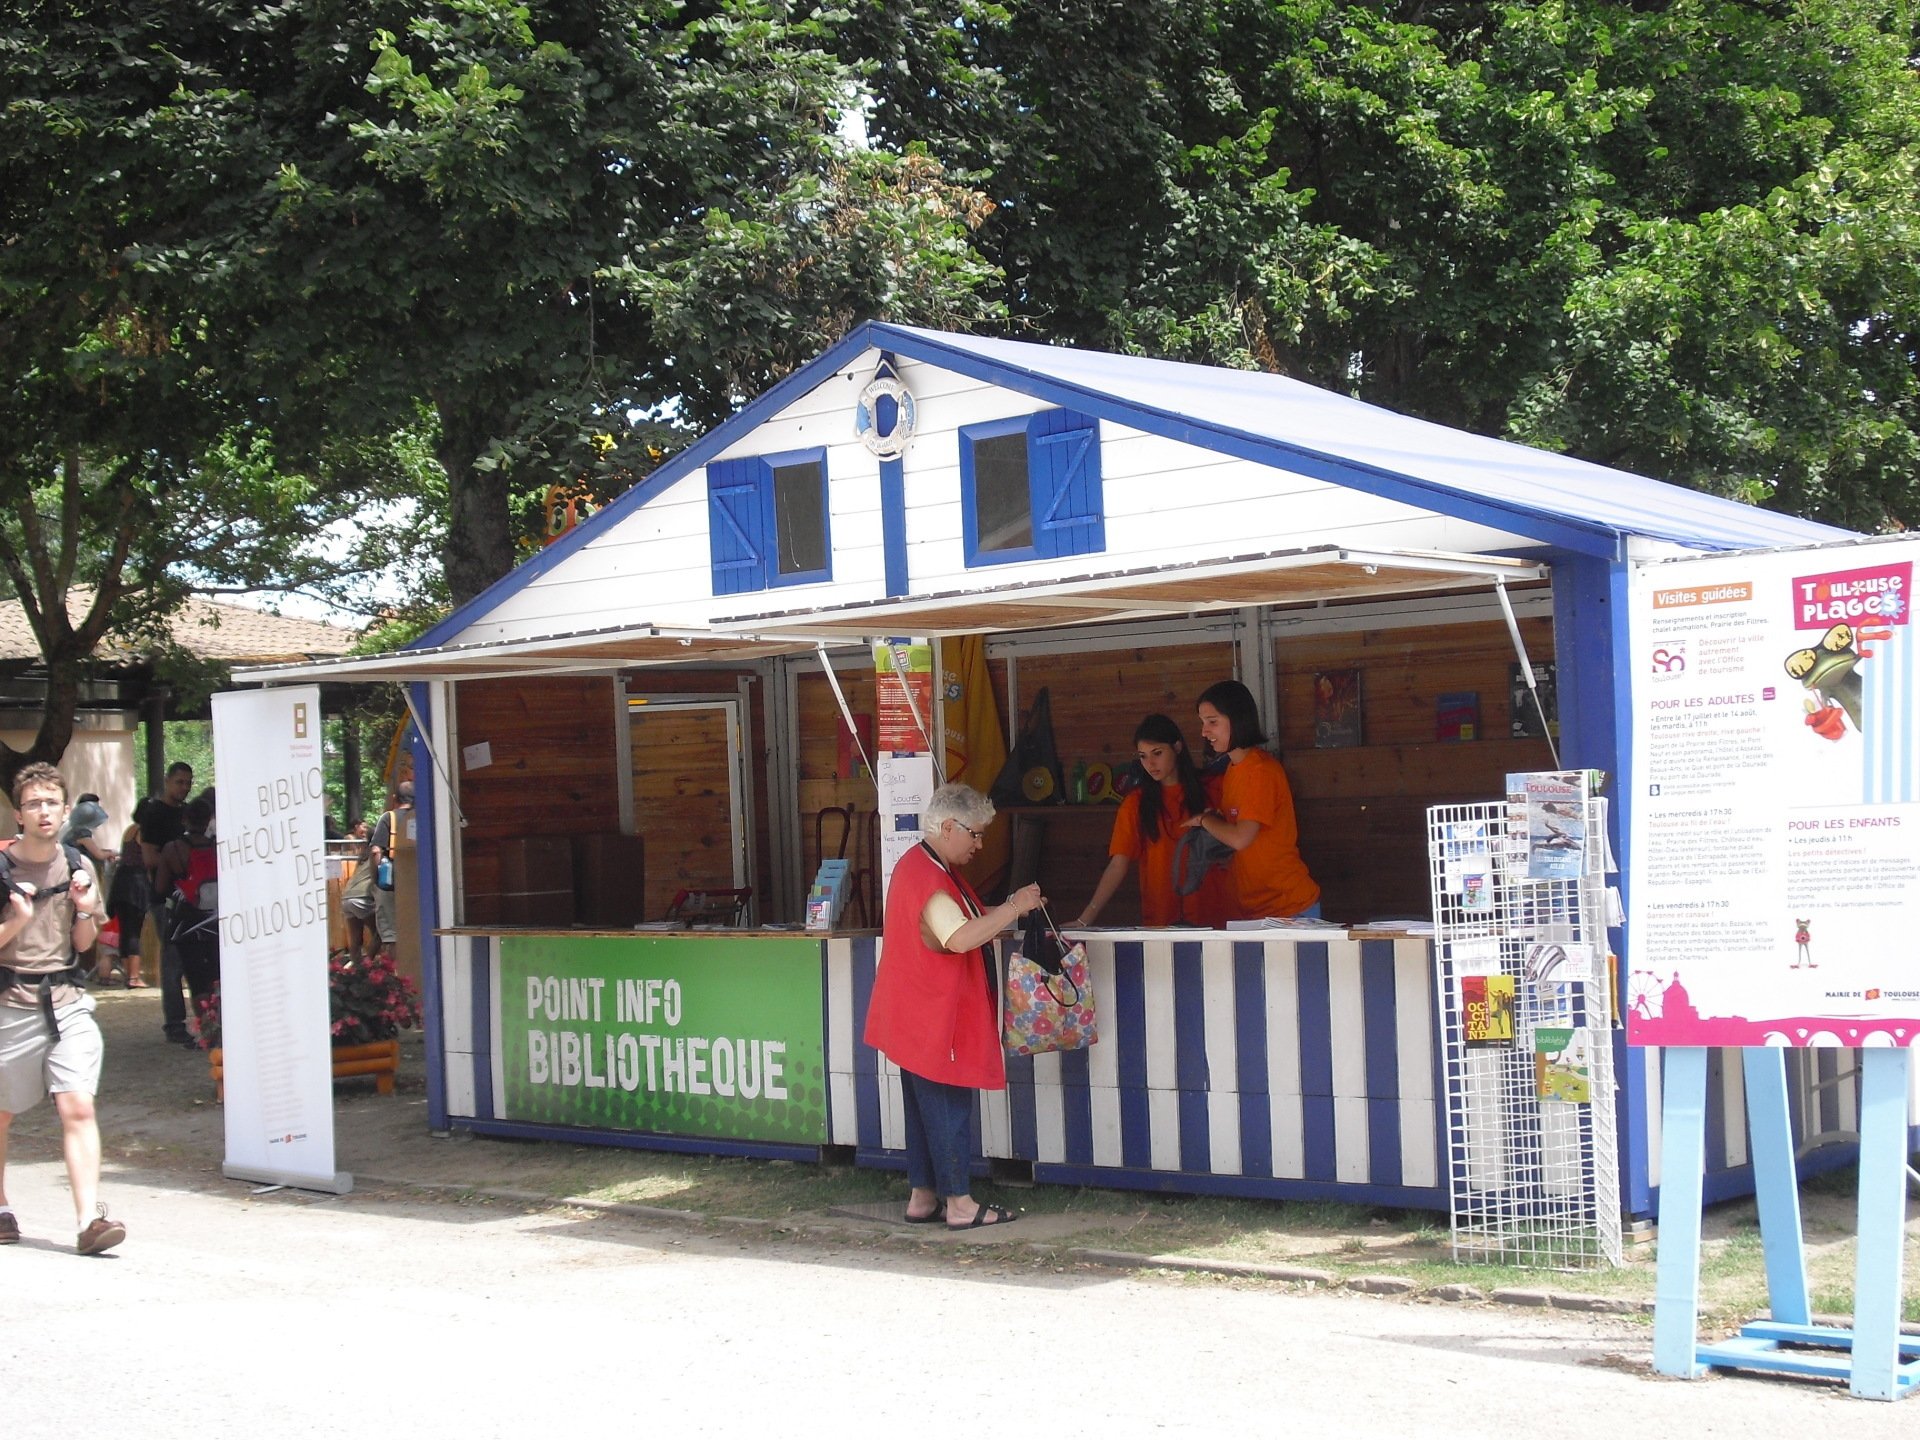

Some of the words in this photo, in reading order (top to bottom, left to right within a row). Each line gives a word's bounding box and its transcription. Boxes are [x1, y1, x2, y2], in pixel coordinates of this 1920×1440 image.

[868, 381, 895, 394] WELCOME
[1657, 592, 1697, 605] Visites
[1701, 587, 1747, 603] guidées
[1653, 614, 1704, 626] Renseignements
[1706, 613, 1712, 621] et
[1714, 611, 1747, 620] inscription
[1653, 626, 1671, 634] chalet
[1710, 620, 1732, 629] Prairie
[1748, 634, 1765, 642] ville
[1699, 646, 1739, 656] autrement
[1699, 658, 1716, 666] avec
[1718, 655, 1745, 664] l'Office
[1699, 667, 1707, 675] de
[1709, 665, 1745, 674] tourisme
[1651, 699, 1680, 710] POUR
[1684, 697, 1704, 708] LES
[1708, 694, 1755, 706] ADULTES
[1656, 715, 1674, 723] Entre
[1692, 712, 1712, 721] juillet
[1651, 723, 1660, 731] les
[1662, 722, 1687, 730] mardis,
[1651, 732, 1680, 740] Toulouse
[1736, 727, 1761, 735] gauche
[257, 766, 323, 818] BIBLIO
[1655, 811, 1667, 819] Les
[1668, 810, 1702, 818] mercredis
[1788, 820, 1820, 831] POUR
[1824, 818, 1845, 829] LES
[1849, 816, 1901, 828] ENFANTS
[1794, 836, 1807, 844] Les
[1809, 835, 1830, 845] jeudis
[1832, 835, 1837, 843] à
[1803, 849, 1823, 857] petits
[294, 848, 324, 887] DE
[1666, 901, 1699, 909] vendredis
[219, 888, 328, 949] TOULOUSE
[527, 975, 605, 1022] POINT
[616, 978, 682, 1026] INFO
[1884, 990, 1920, 998] TOULOUSE
[527, 1029, 788, 1100] BIBLIOTHEQUE
